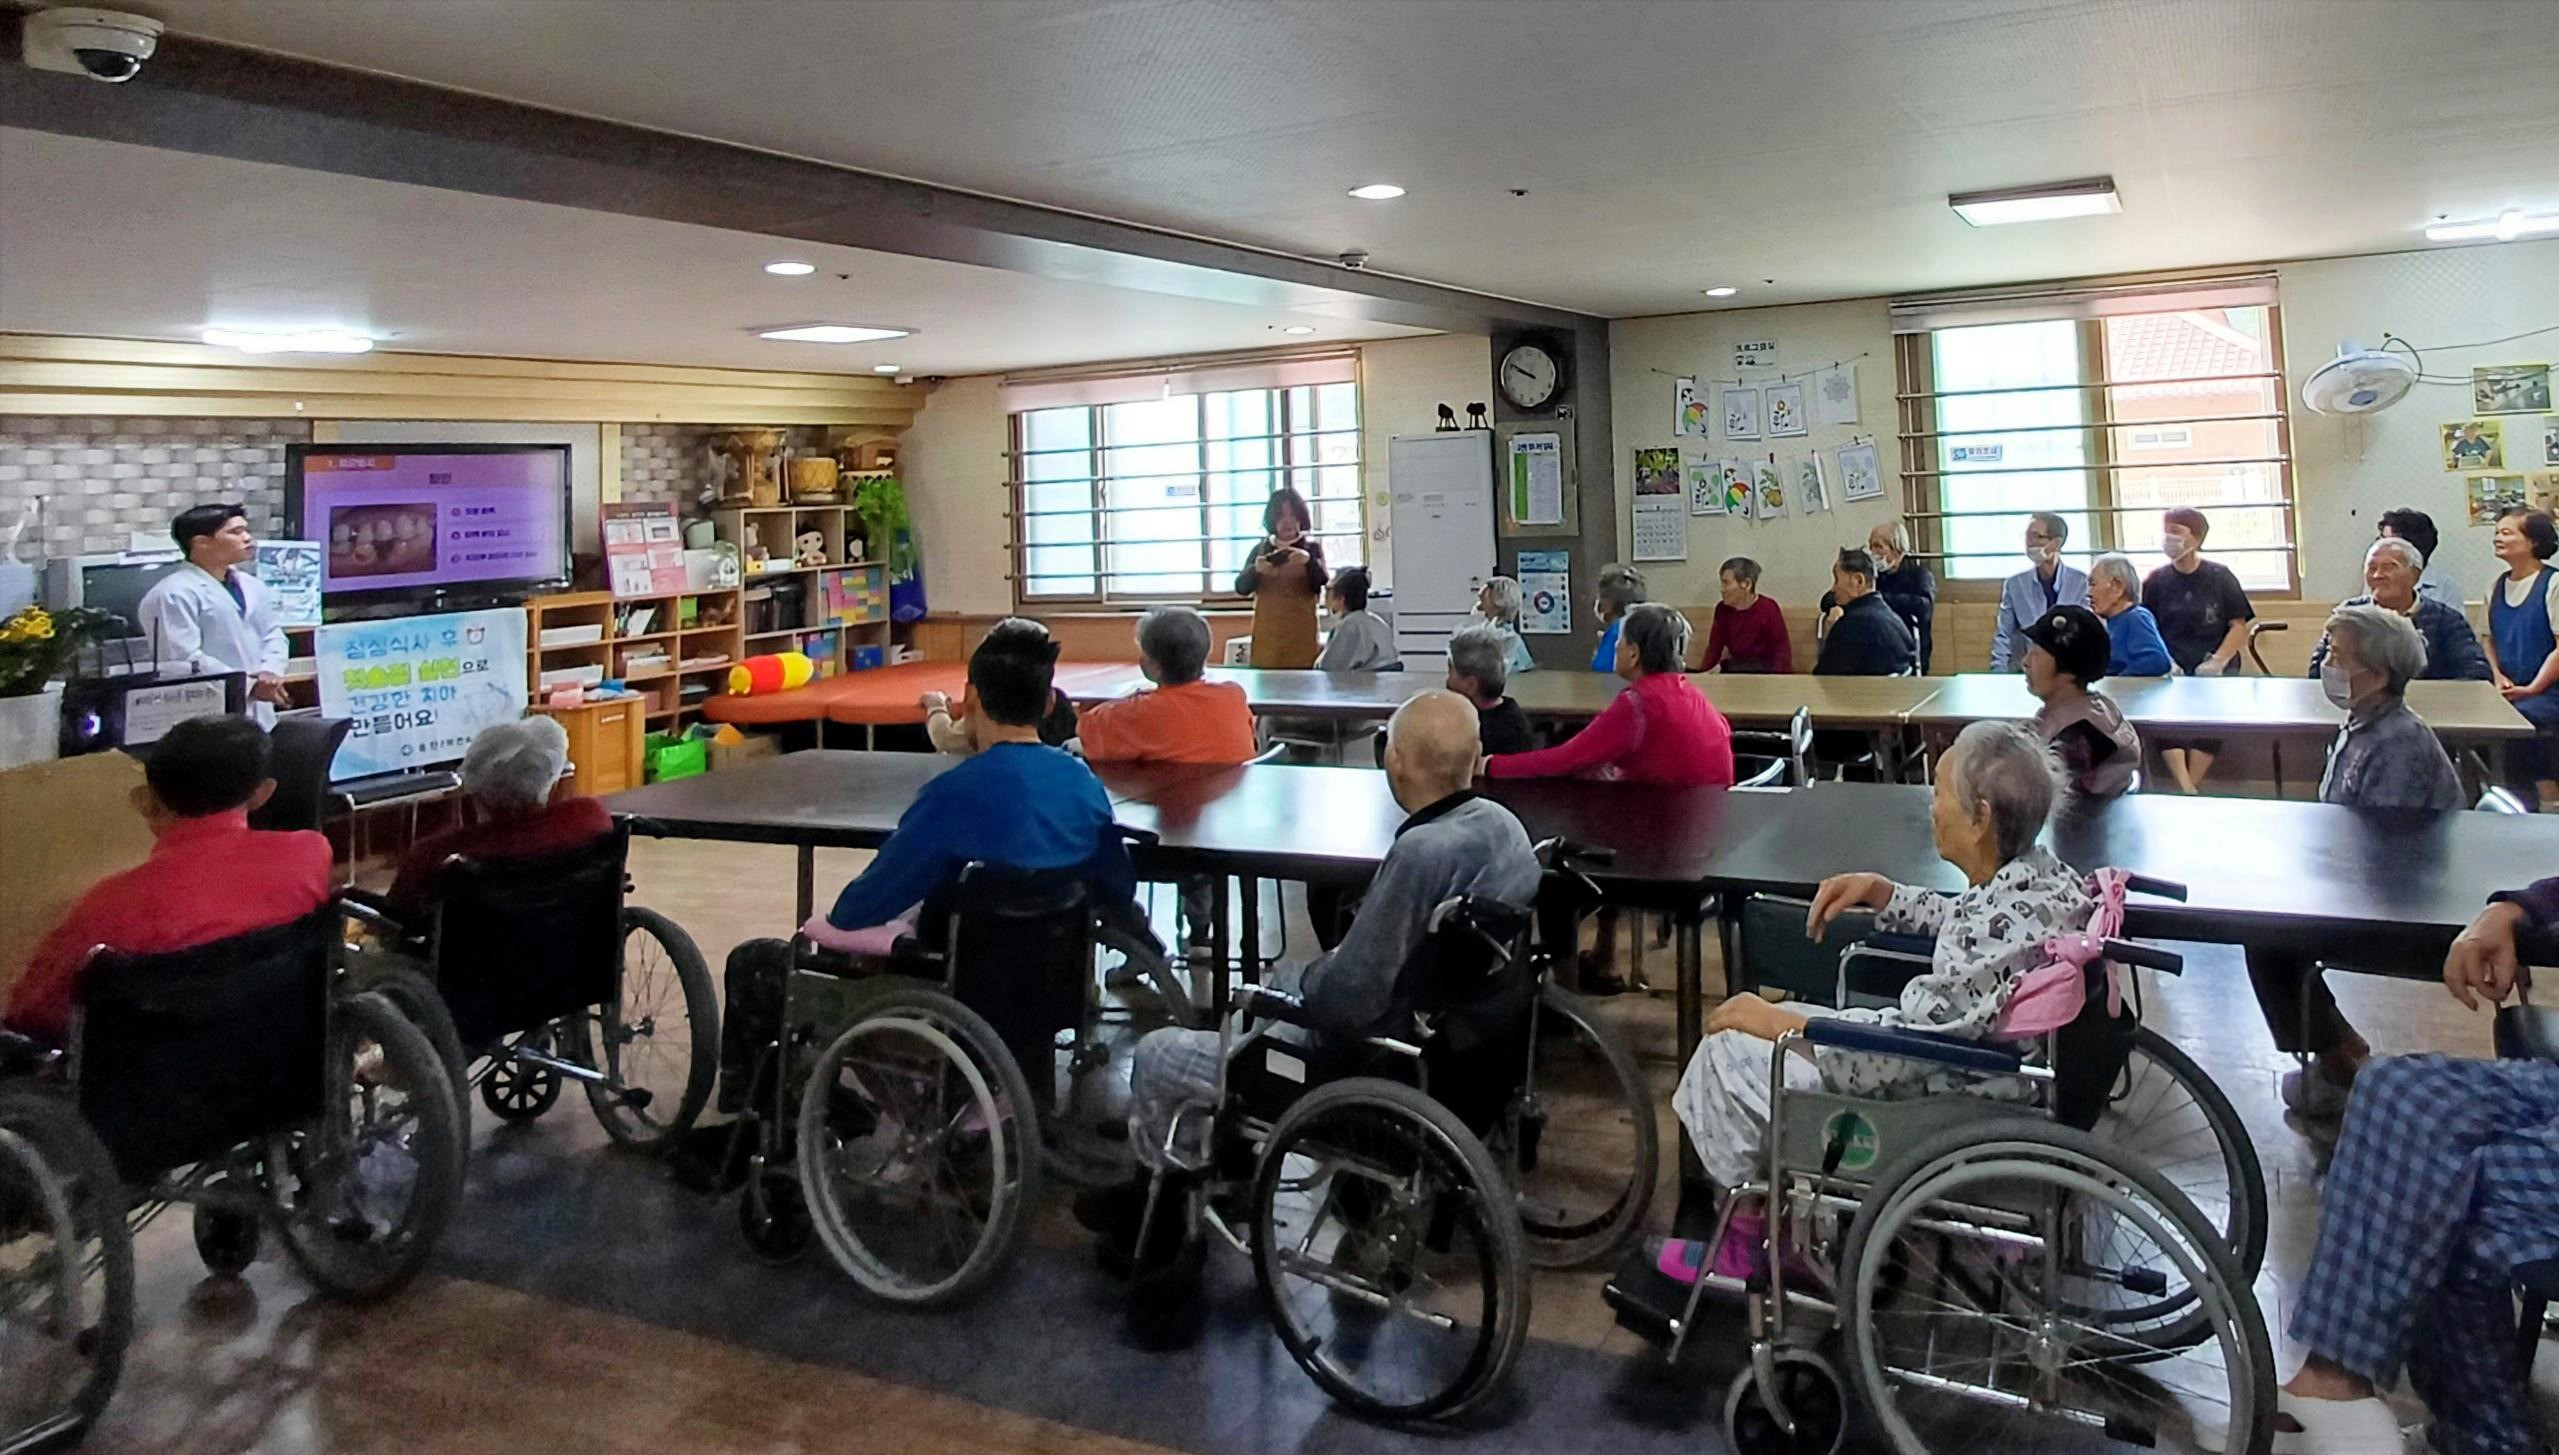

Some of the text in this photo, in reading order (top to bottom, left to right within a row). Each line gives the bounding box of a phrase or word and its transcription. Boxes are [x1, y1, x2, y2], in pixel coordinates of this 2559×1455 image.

[345, 629, 457, 660] 점심식사 후
[351, 685, 458, 715] 건강한 치아
[350, 708, 439, 738] 만들어요!
